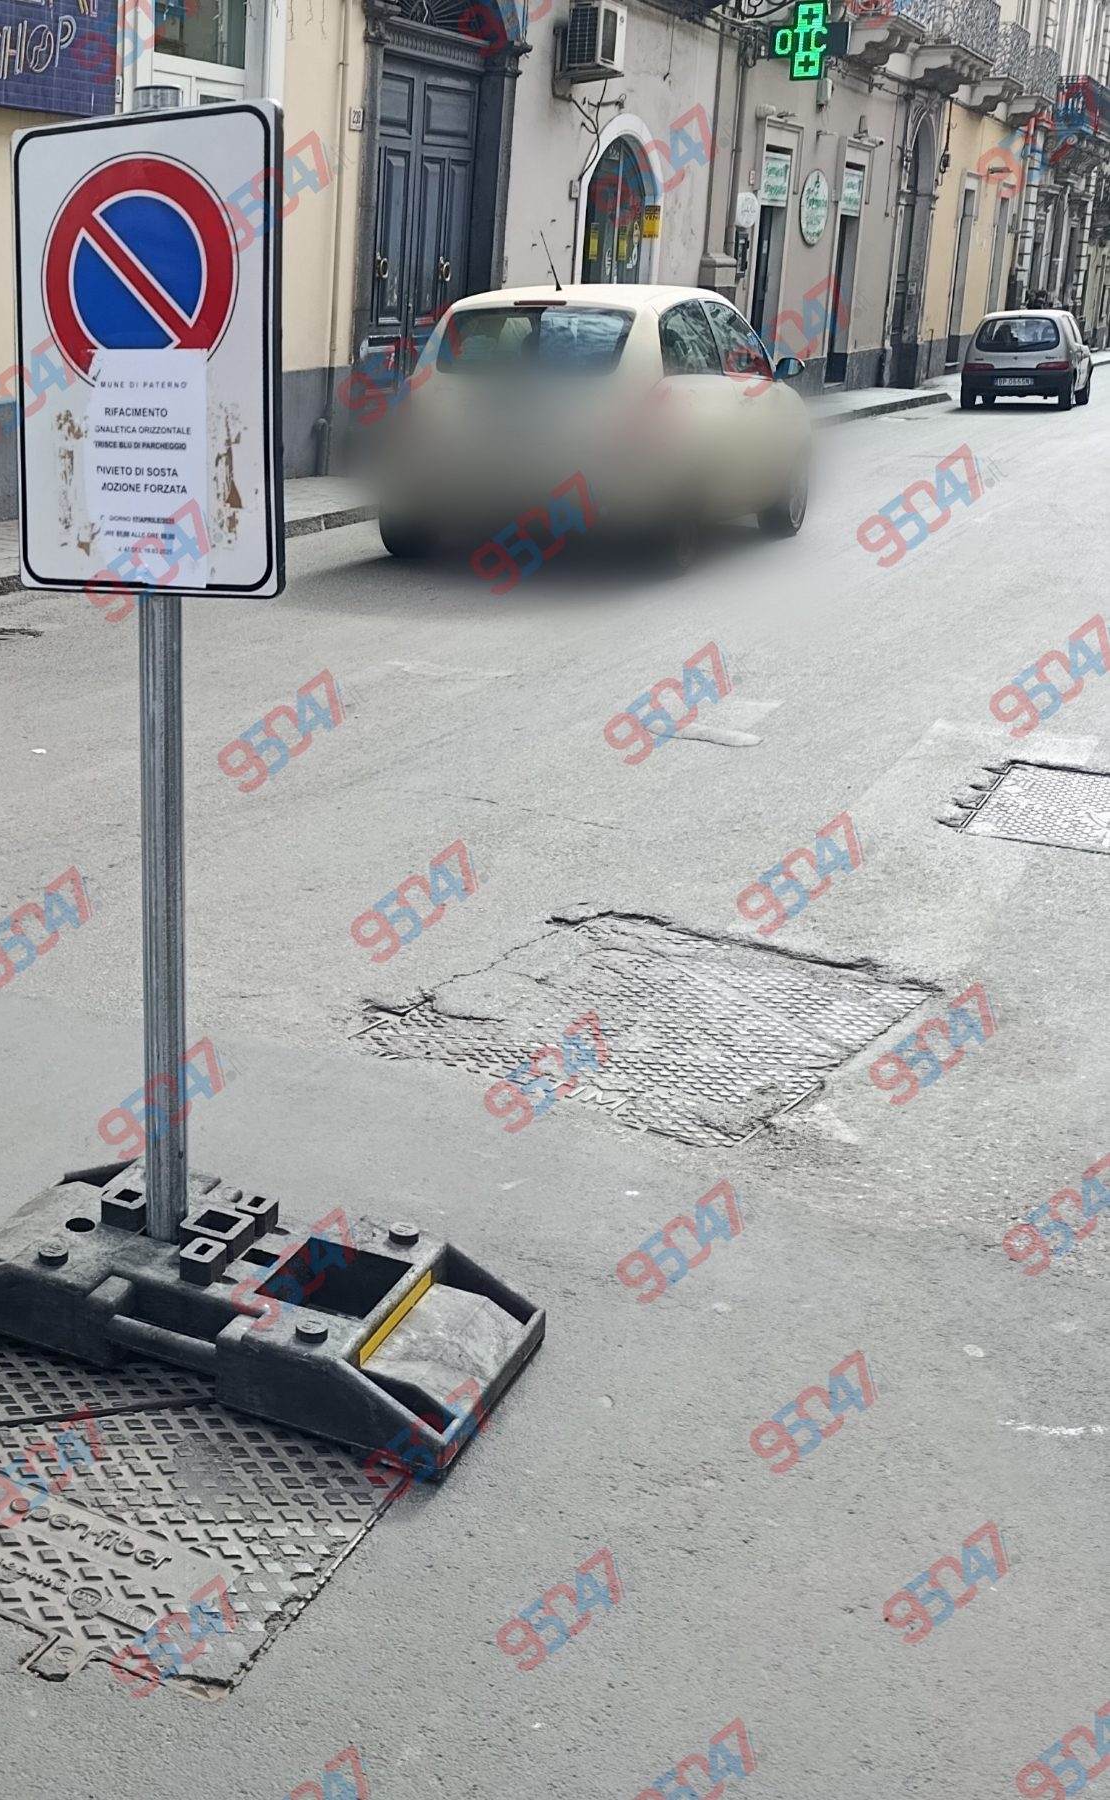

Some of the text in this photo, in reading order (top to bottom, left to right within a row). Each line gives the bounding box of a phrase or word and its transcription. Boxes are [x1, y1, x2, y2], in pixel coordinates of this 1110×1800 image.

[775, 26, 828, 54] OTC
[100, 381, 124, 389] MUNE
[129, 381, 138, 389] DI
[104, 407, 168, 418] RIFACIMENTO
[94, 425, 191, 435] GNALETICA ORIZZONTALE
[93, 441, 187, 450] TRISCE BLU DI PARCHEGGIO
[96, 465, 178, 477] DIVIETO DI SOSTA
[101, 482, 188, 494] MOZIONE FORZATA
